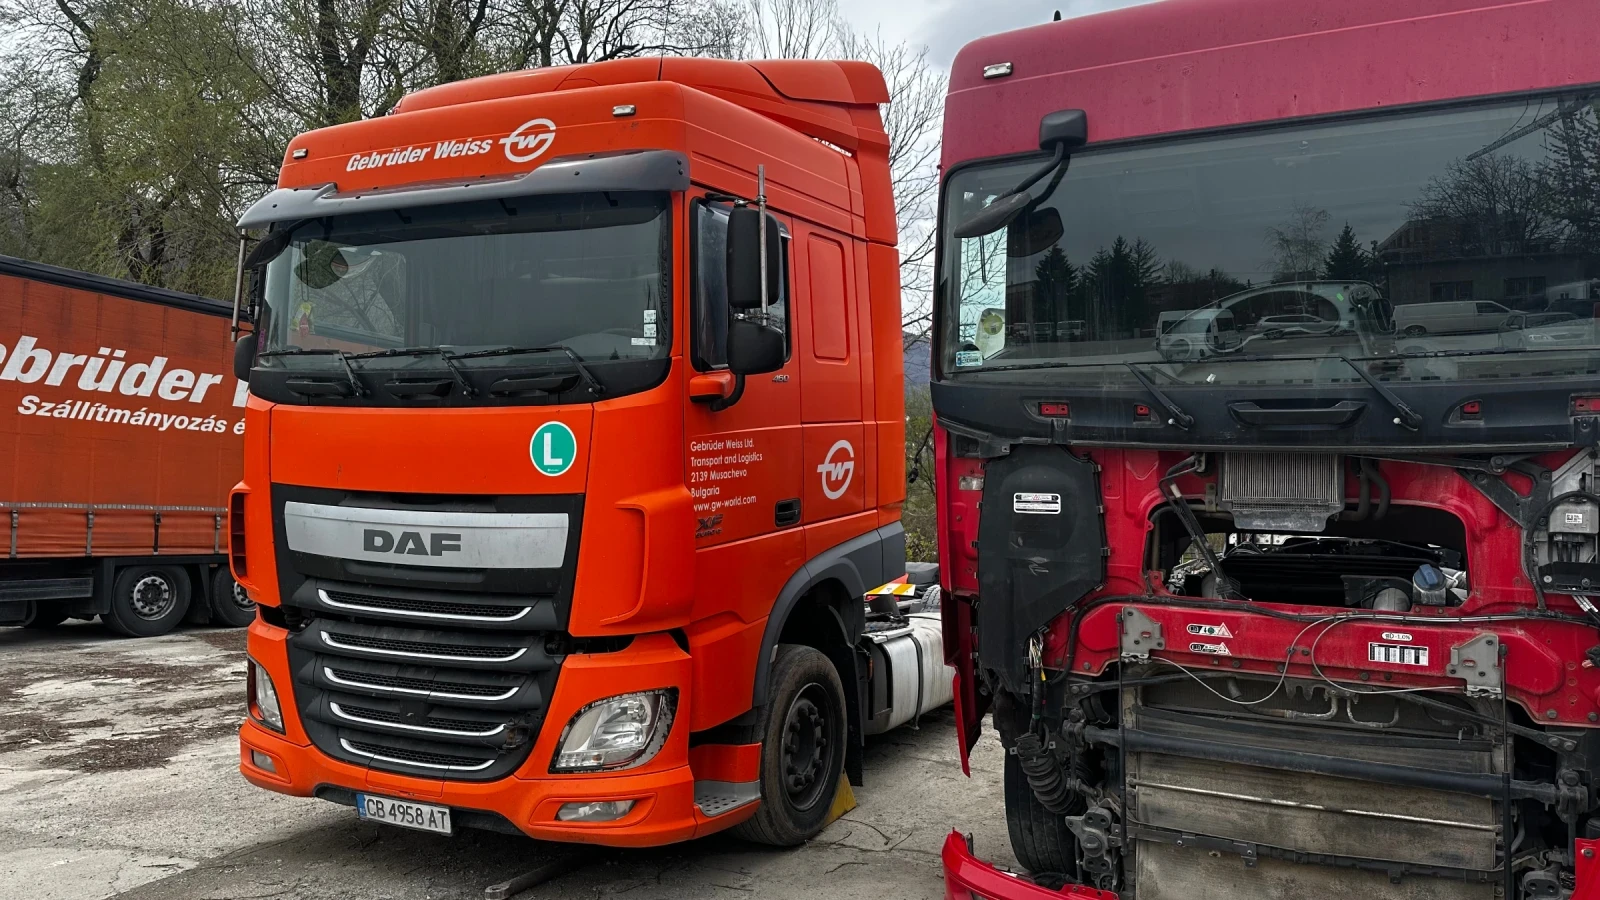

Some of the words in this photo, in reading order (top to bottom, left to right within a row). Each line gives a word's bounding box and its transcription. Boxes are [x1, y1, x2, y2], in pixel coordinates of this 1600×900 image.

[346, 147, 431, 172] Gebrüder
[433, 137, 493, 160] Weiss
[17, 395, 228, 432] Szállítmányozás
[543, 432, 563, 466] L
[690, 440, 724, 452] Gebrüder
[725, 439, 743, 449] Weiss
[744, 438, 755, 448] Ltd.
[690, 454, 723, 468] Transport
[724, 453, 737, 464] and
[738, 451, 763, 465] Logistics
[690, 471, 708, 483] 2139
[709, 468, 748, 481] Musachevo
[690, 485, 720, 499] Bulgaria
[693, 495, 757, 512] www.gw-world.com
[363, 528, 462, 557] DAF
[366, 799, 385, 818] CB
[388, 803, 424, 825] 4958
[428, 809, 447, 829] AT
